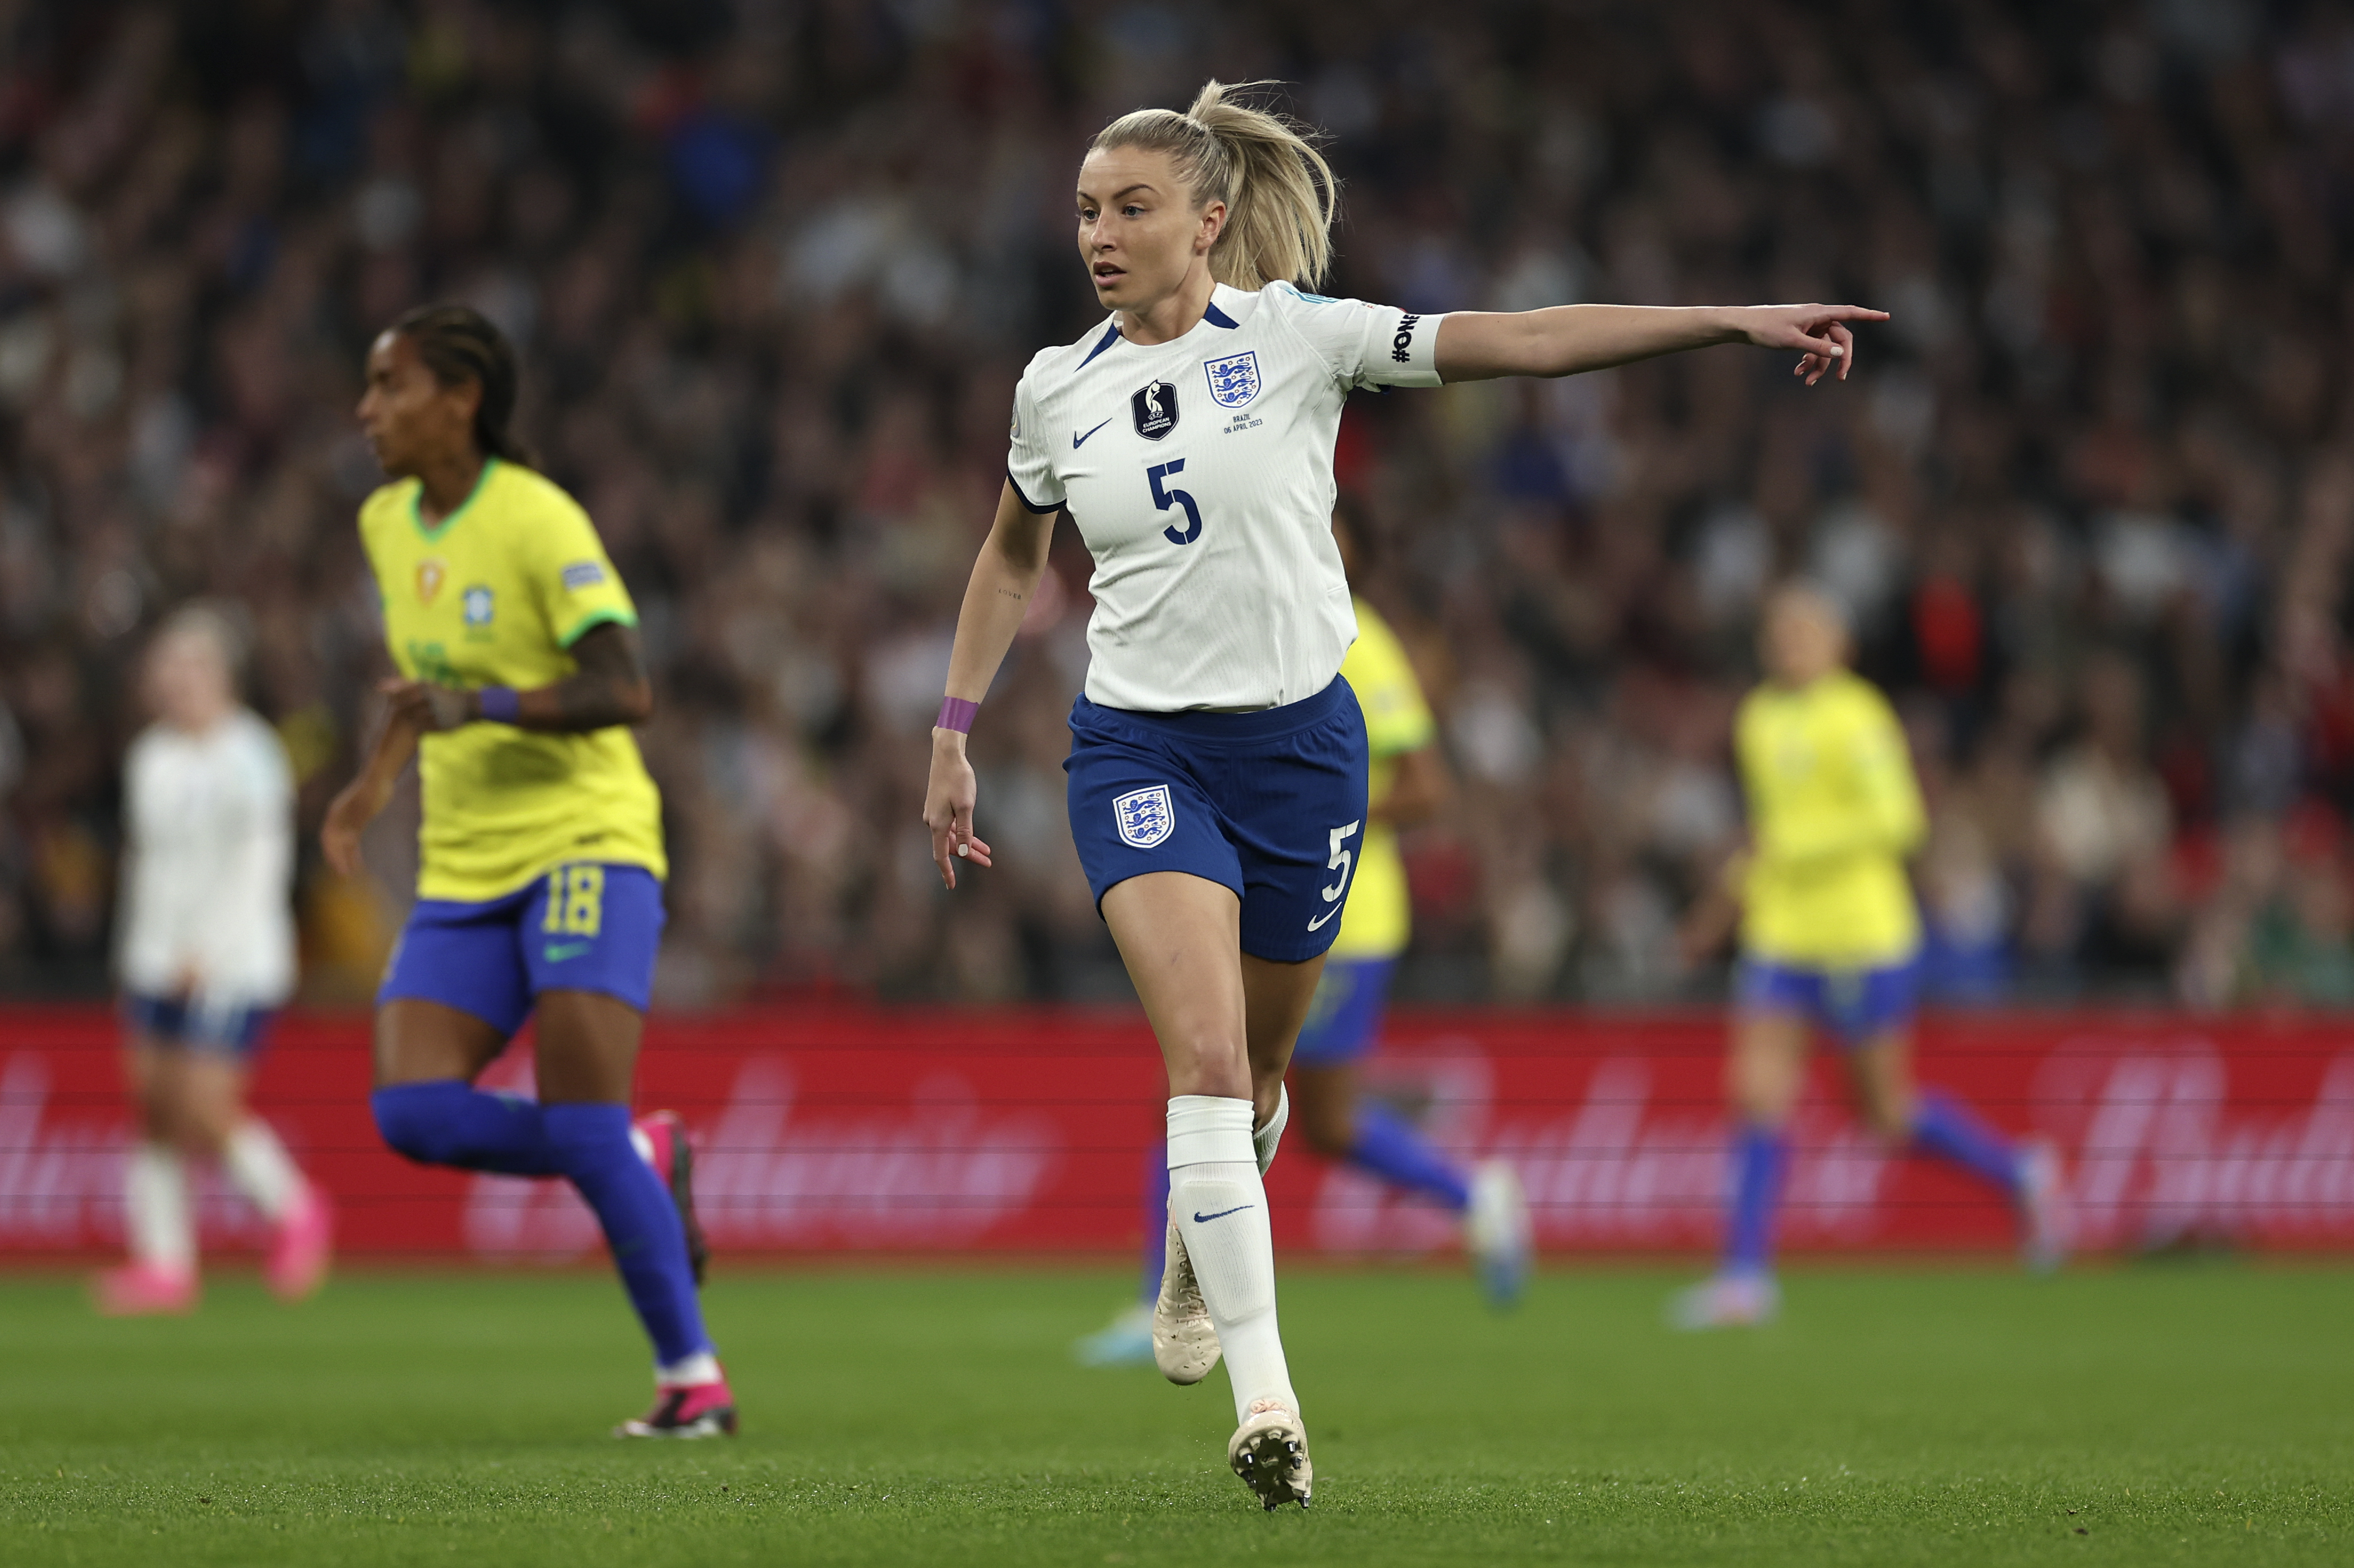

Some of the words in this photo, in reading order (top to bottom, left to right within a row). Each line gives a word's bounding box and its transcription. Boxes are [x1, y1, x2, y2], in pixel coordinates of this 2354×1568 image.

[1143, 417, 1170, 428] EUROPEAN
[1233, 414, 1250, 423] BRAZIL
[1233, 423, 1248, 432] APRIL
[1249, 418, 1263, 428] 2023
[1142, 421, 1172, 433] CHAMPIONS
[1146, 457, 1202, 545] 5
[1322, 819, 1360, 903] 5
[542, 866, 604, 937] 18
